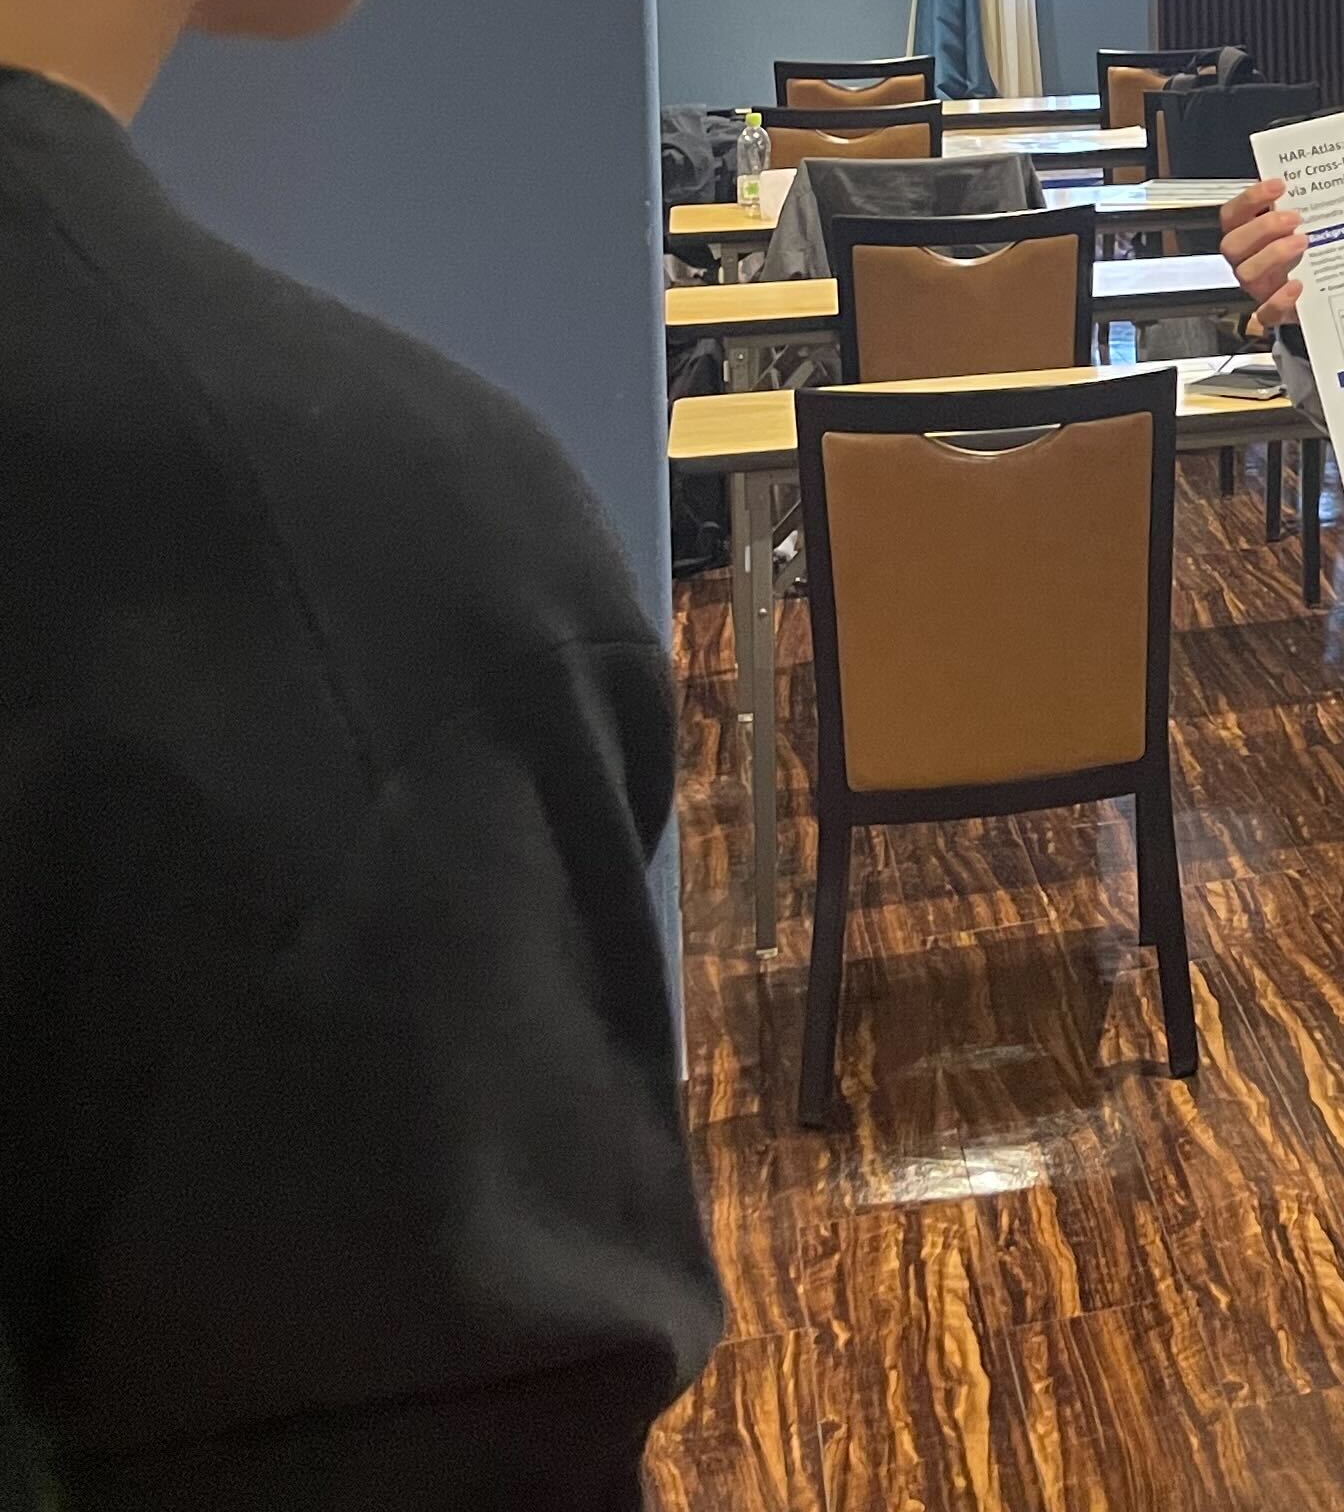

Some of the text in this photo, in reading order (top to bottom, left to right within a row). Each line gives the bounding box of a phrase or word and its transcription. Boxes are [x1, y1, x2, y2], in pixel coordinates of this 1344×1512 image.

[1278, 142, 1344, 164] HAR-Atlas:
[1282, 169, 1301, 181] for
[1286, 185, 1307, 197] via
